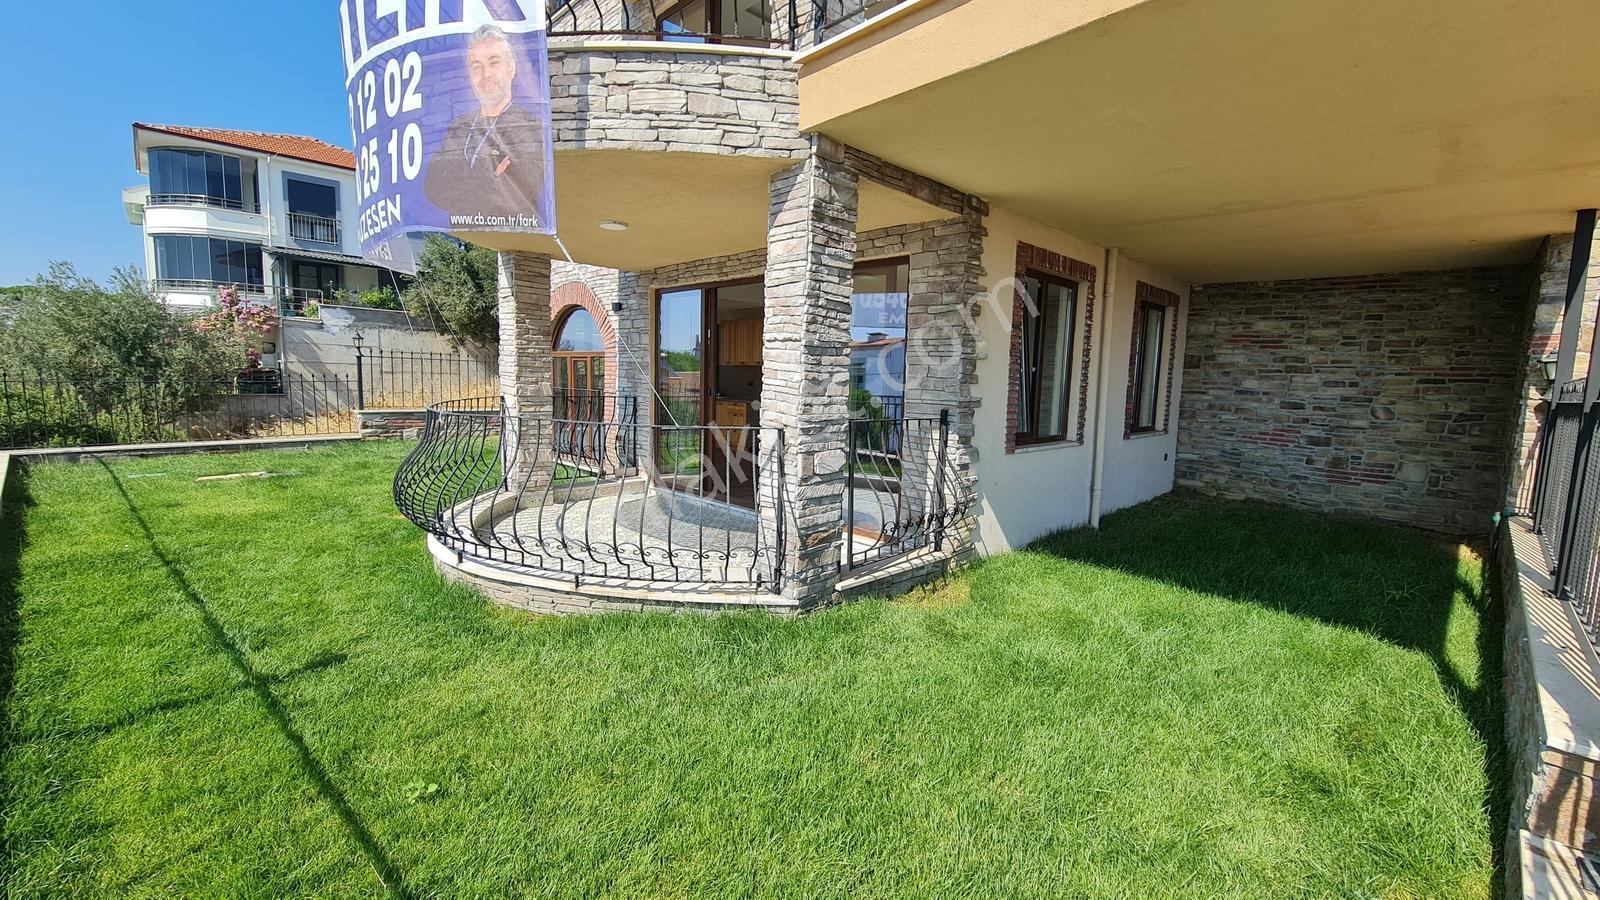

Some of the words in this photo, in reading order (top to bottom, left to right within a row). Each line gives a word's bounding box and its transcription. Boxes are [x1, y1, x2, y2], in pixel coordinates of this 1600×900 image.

[357, 70, 377, 134] 12
[384, 51, 422, 118] 02
[361, 137, 380, 199] 25
[388, 122, 423, 184] 10
[450, 211, 538, 227] www.cb.com.tr/fark
